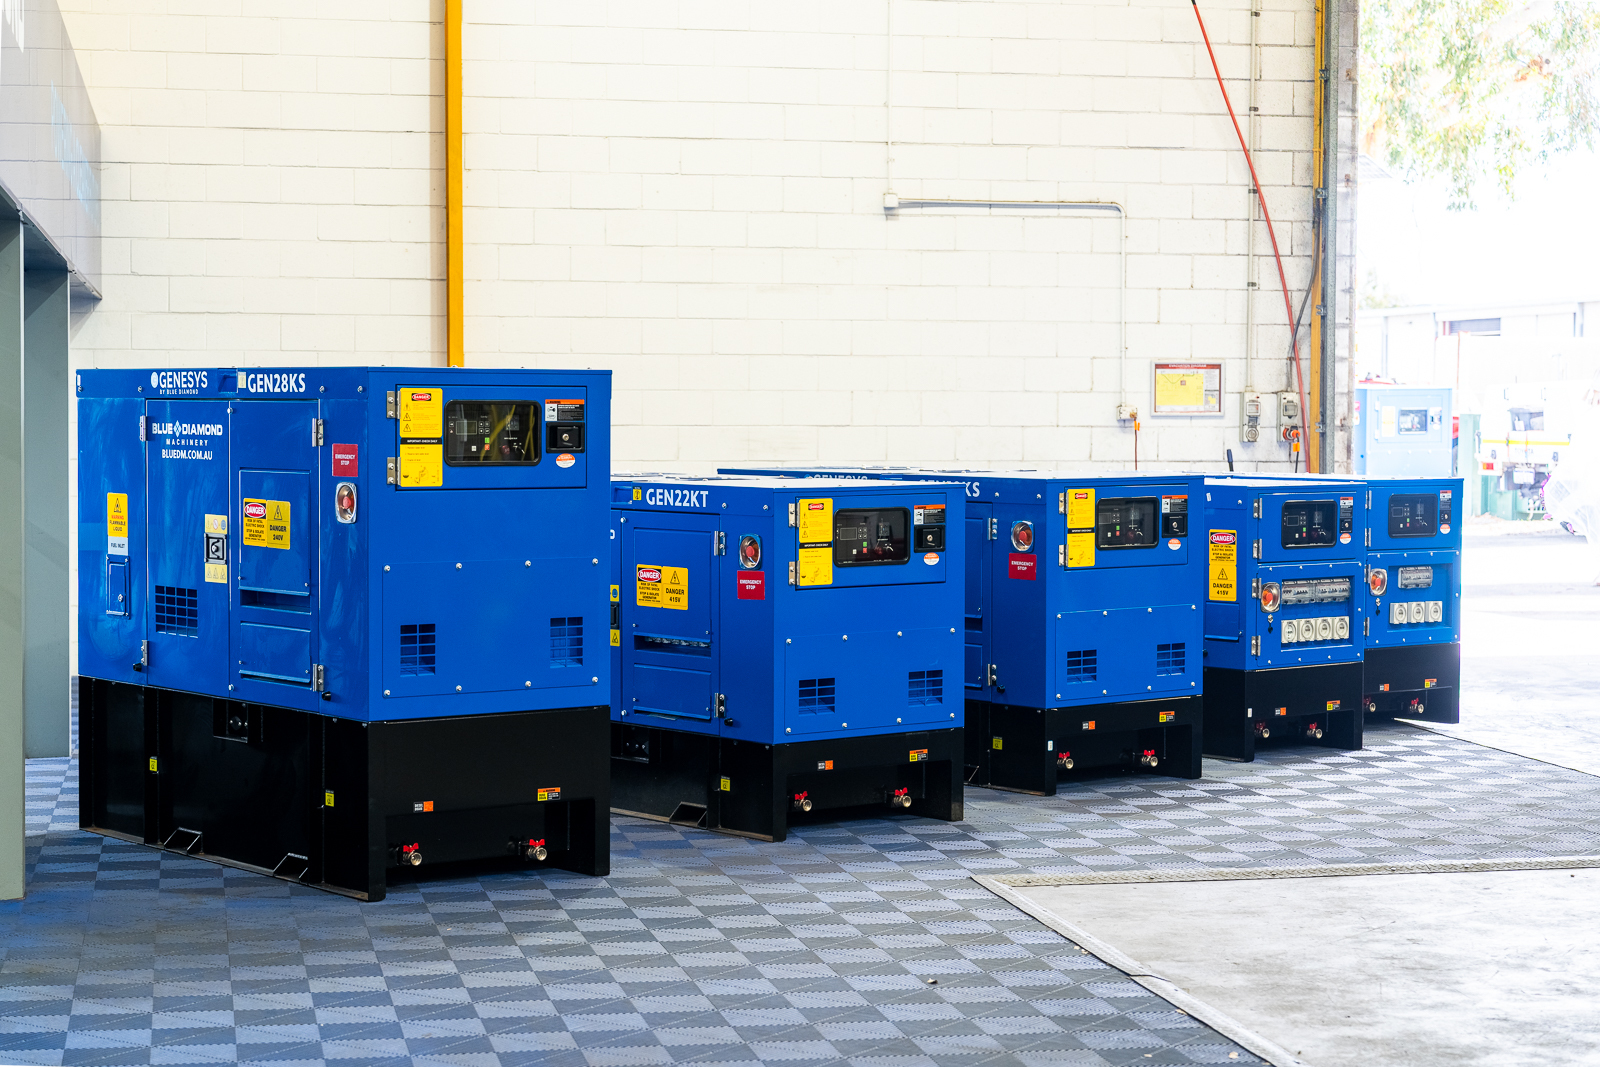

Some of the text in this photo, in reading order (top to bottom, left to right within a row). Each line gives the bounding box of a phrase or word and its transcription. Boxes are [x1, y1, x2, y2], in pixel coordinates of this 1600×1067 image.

[159, 371, 208, 388] GENESYS
[247, 373, 306, 393] GEN28KS
[152, 423, 223, 436] BLUE DIAMOND
[162, 449, 212, 460] BLUEDM.COM.AU
[646, 488, 708, 508] GEN22KT
[246, 506, 264, 514] DANGER
